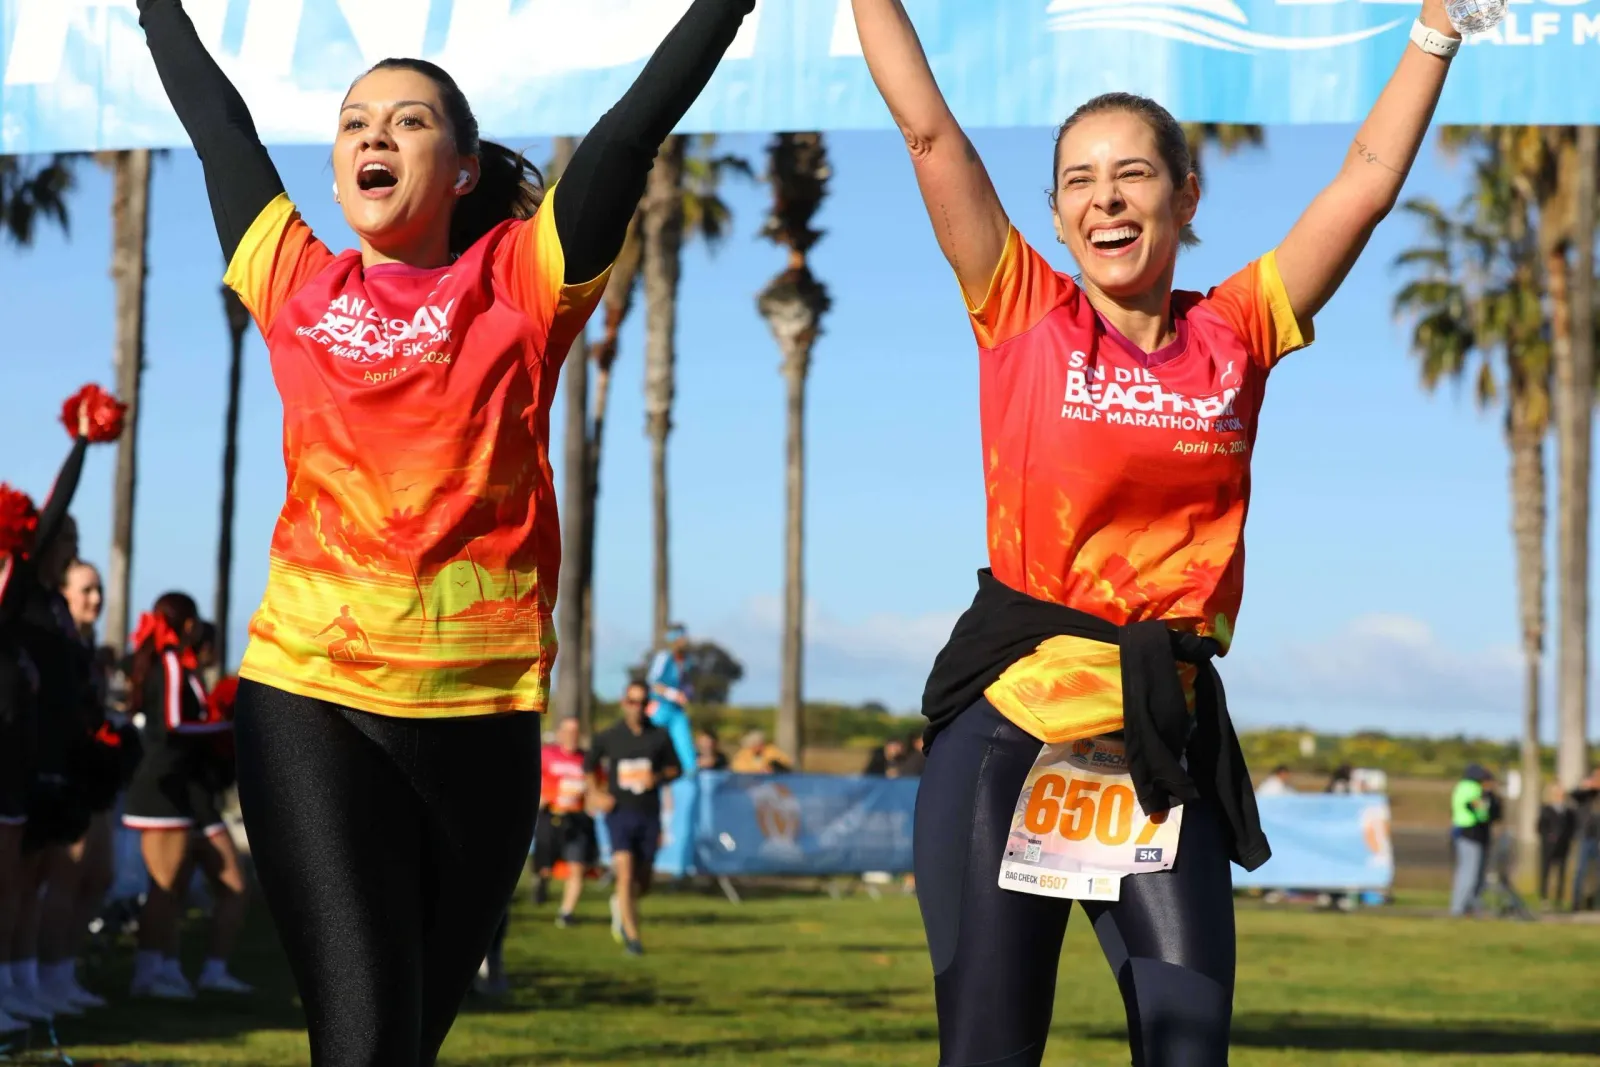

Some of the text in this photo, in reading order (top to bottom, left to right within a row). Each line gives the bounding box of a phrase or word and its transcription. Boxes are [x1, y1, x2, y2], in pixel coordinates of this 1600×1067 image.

[1459, 12, 1560, 45] ALF
[296, 326, 332, 345] HALF
[402, 342, 424, 357] 5K
[363, 368, 397, 384] April
[419, 351, 452, 365] 2024
[1115, 366, 1160, 383] DIE
[1064, 370, 1182, 413] BEACH
[1061, 404, 1101, 422] HALF
[1107, 412, 1209, 432] MARATHON
[1173, 440, 1209, 455] April
[1212, 443, 1228, 456] 14,
[1139, 850, 1157, 860] 5K
[1005, 870, 1018, 880] BAG
[1018, 873, 1038, 884] CHECK
[1039, 875, 1068, 890] 6507
